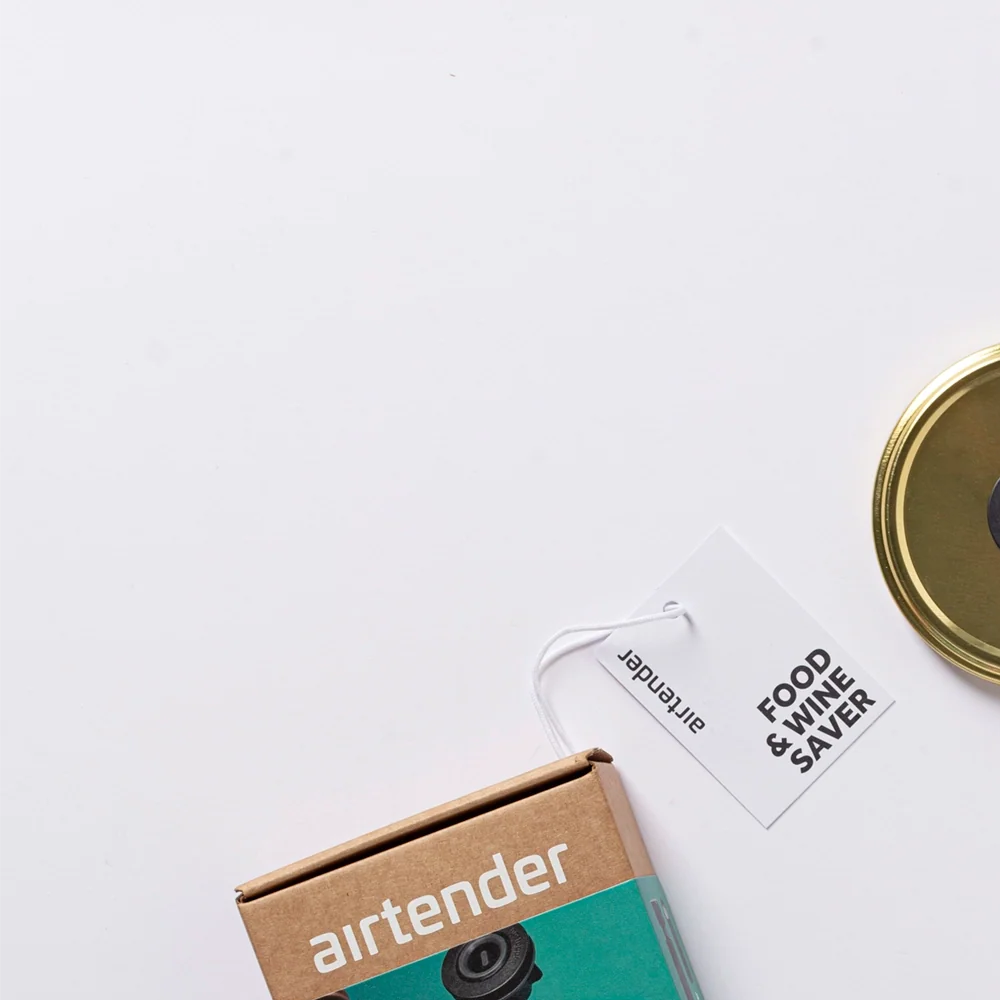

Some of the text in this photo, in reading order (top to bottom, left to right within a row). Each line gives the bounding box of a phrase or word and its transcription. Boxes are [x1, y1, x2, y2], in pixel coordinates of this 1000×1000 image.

[617, 649, 706, 735] airtender
[756, 648, 831, 724] FOOD
[766, 665, 856, 758] & WINE
[790, 688, 877, 774] SAVER
[309, 842, 569, 974] airtender
